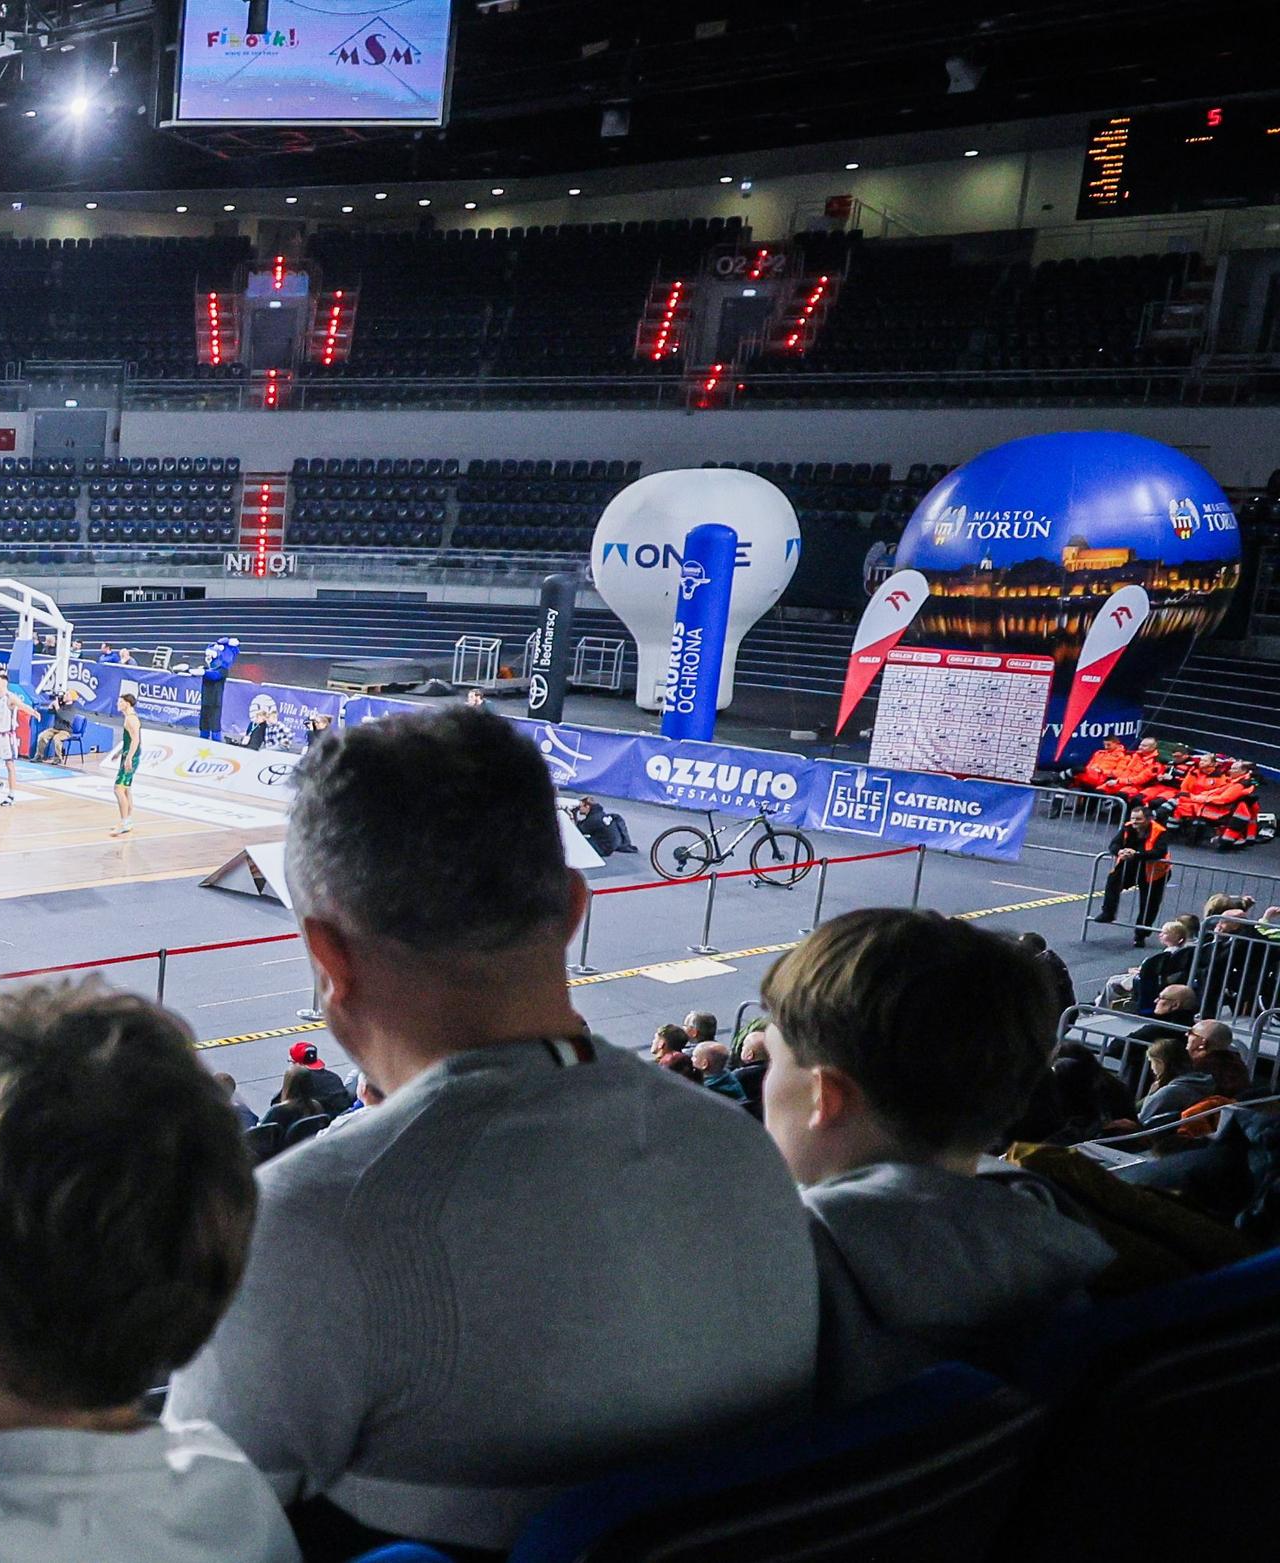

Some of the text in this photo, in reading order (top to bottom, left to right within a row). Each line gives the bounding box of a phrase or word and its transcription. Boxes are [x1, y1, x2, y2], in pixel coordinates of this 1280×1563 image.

[336, 33, 414, 66] MSM
[965, 514, 1052, 540] TORUŃ
[973, 509, 1034, 521] MIASTO
[635, 541, 753, 569] ONE
[540, 607, 559, 667] Bednarscy
[663, 621, 685, 714] TAURUS
[677, 627, 704, 714] OCHRONA
[139, 684, 203, 702] CLEAN WA
[279, 702, 298, 715] Villa
[188, 761, 230, 775] LOTTO
[645, 755, 798, 801] azzurro
[836, 784, 882, 806] ELITE
[894, 790, 983, 817] CATERING
[832, 802, 882, 824] DIET
[890, 814, 1009, 843] DIETETYCZNY
